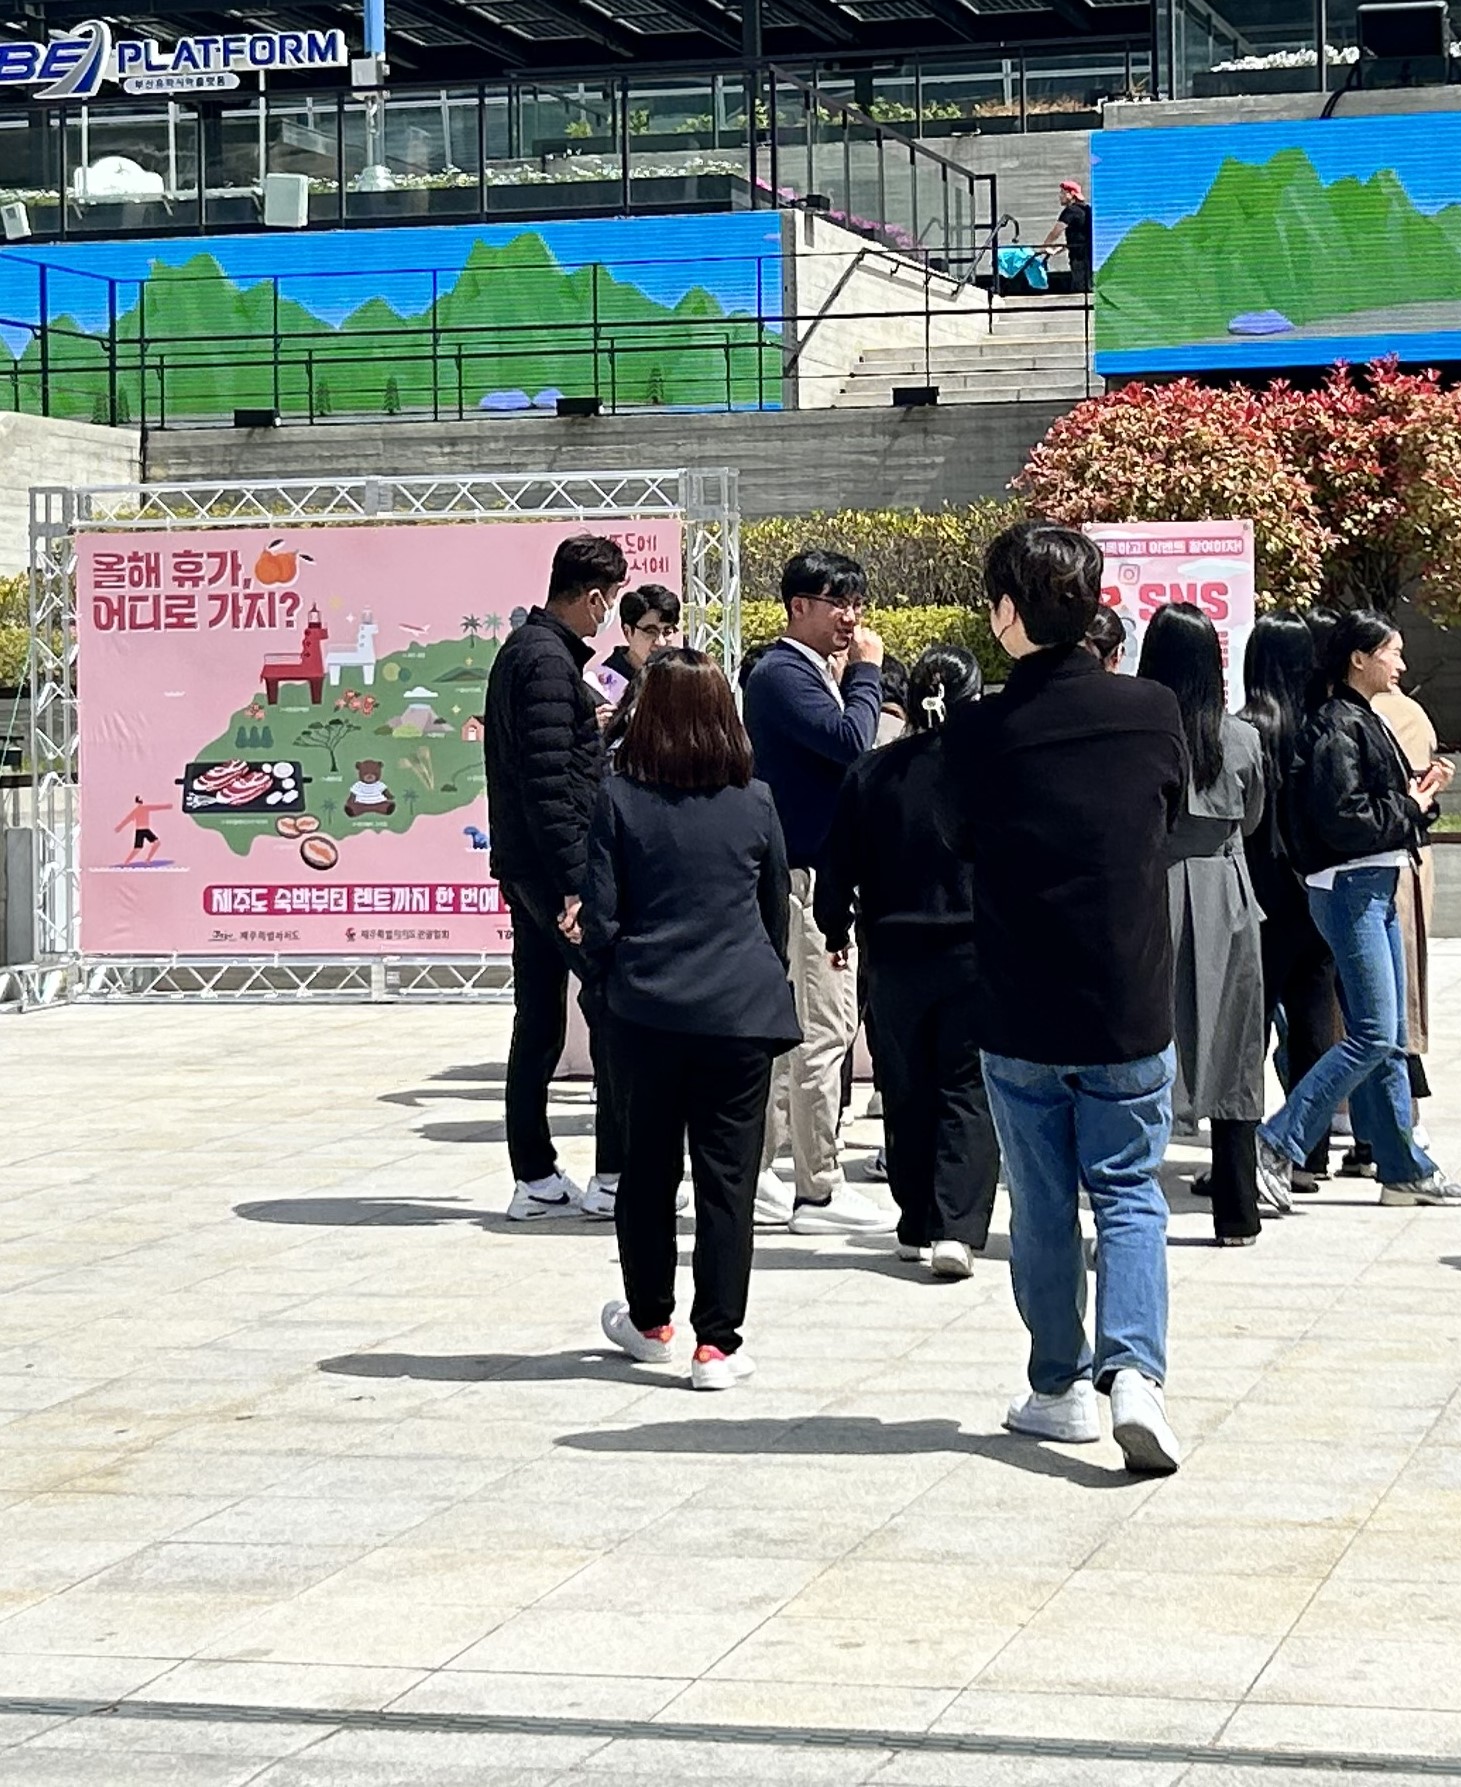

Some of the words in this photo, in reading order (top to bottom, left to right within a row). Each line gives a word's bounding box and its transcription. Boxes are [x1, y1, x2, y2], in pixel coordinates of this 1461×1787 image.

[117, 31, 339, 73] PLATFORM
[629, 556, 669, 574] 서예
[1149, 540, 1185, 555] 이벤트
[93, 551, 161, 589] 올해
[172, 549, 251, 590] 휴가,
[94, 594, 198, 631] 어디로
[208, 592, 300, 628] 가지?
[1138, 582, 1228, 620] SNS
[211, 886, 268, 914] 제주도
[274, 886, 348, 914] 숙박부터
[353, 886, 430, 913] 렌트까지
[435, 887, 455, 911] 한
[460, 886, 499, 912] 번에
